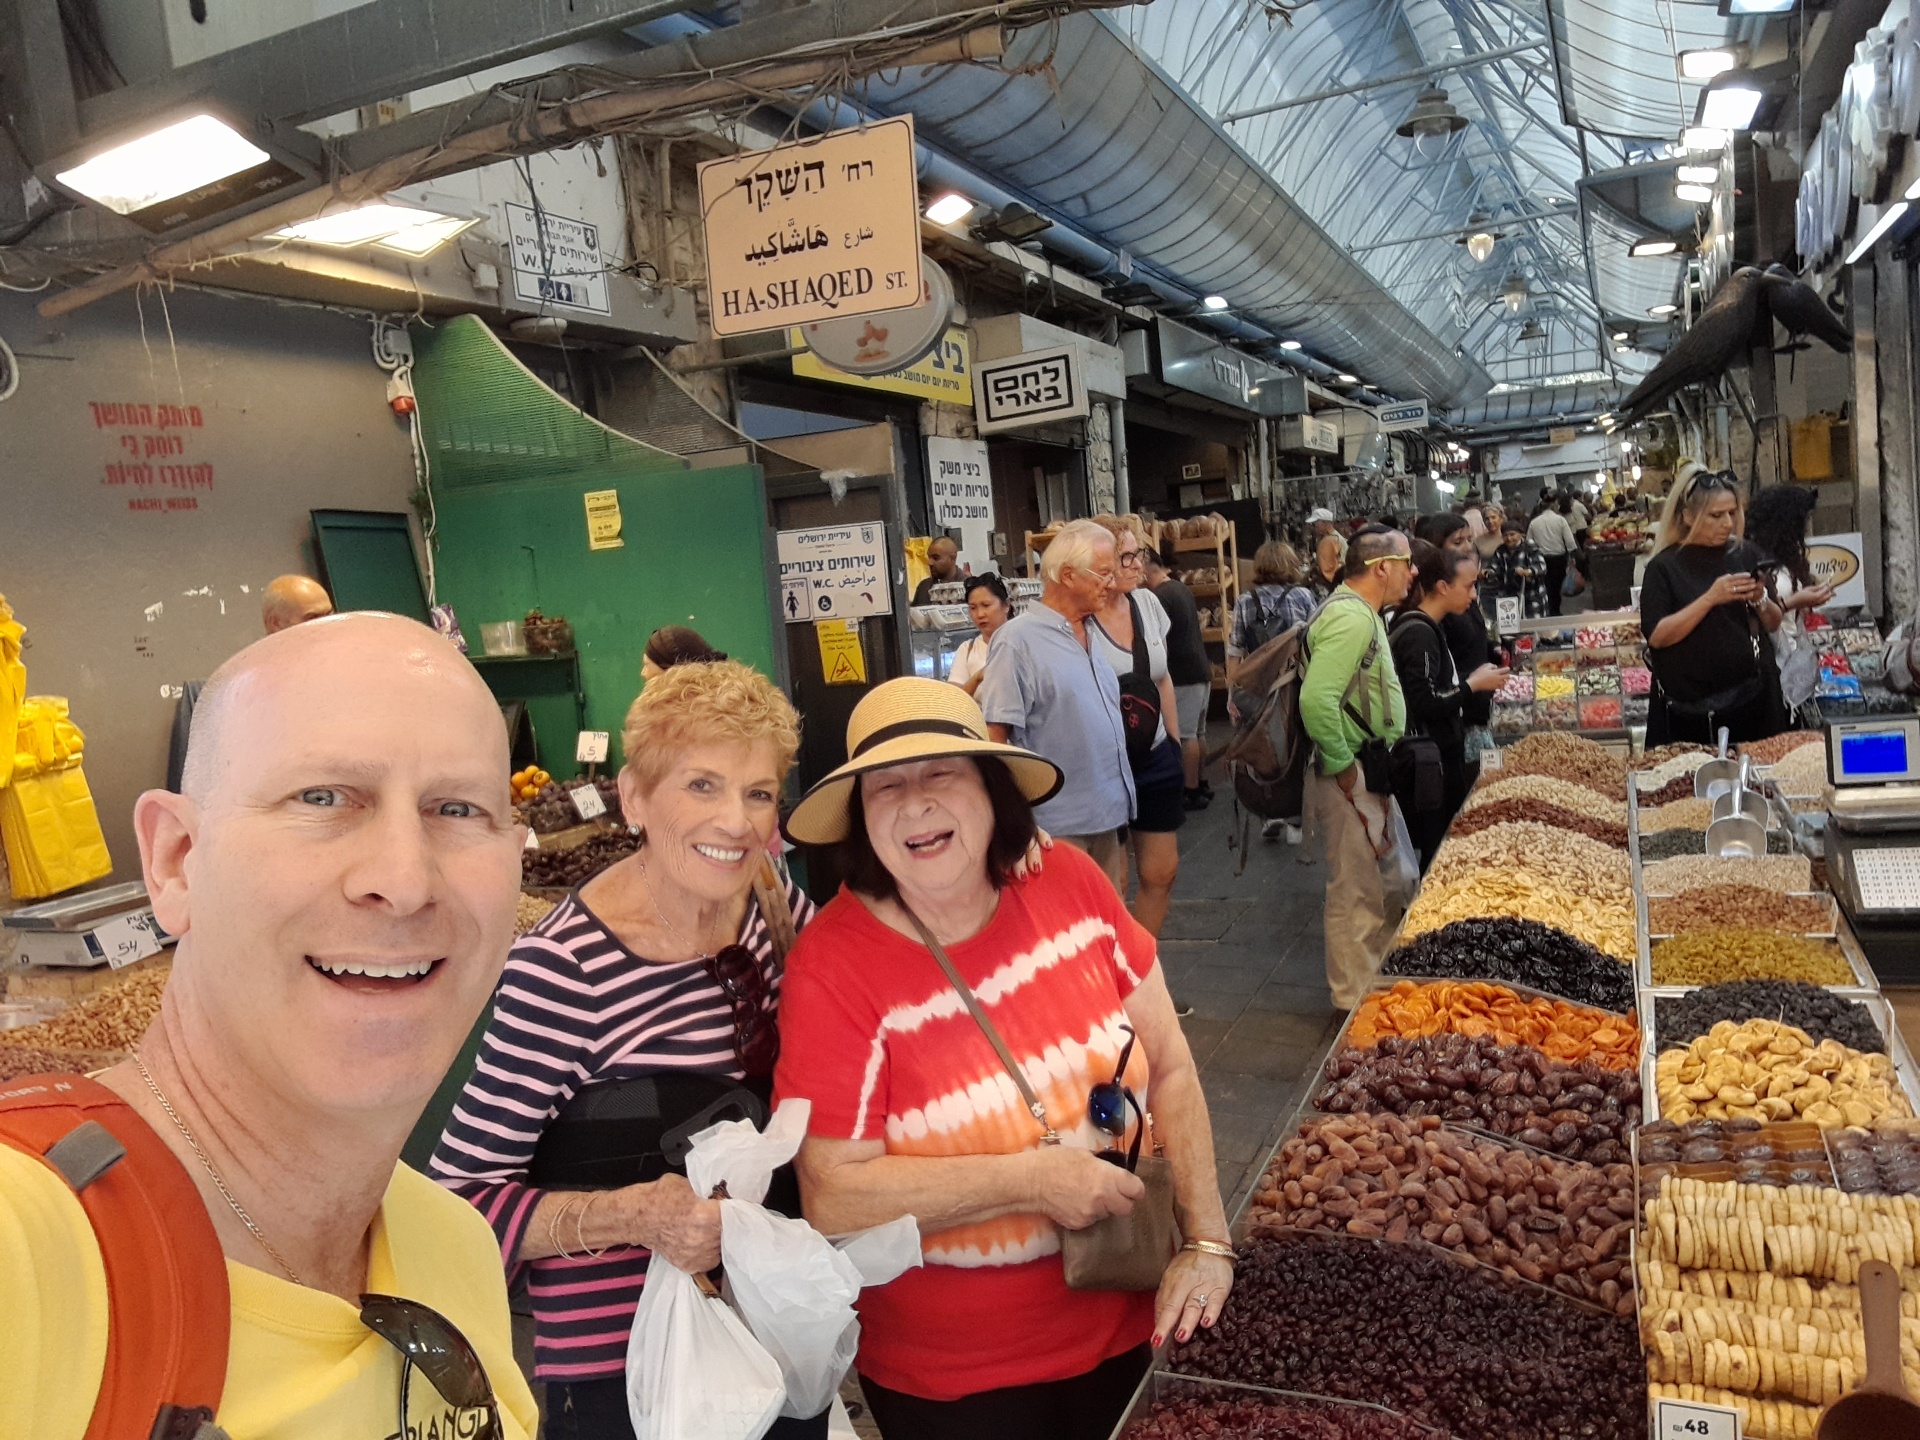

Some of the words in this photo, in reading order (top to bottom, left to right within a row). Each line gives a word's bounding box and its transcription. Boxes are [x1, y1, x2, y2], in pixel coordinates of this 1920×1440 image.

[843, 226, 874, 249] شارع
[560, 246, 598, 265] שירותים
[722, 266, 873, 318] HA-SHAQED
[885, 271, 908, 290] ST.
[903, 370, 921, 382] מושב
[921, 374, 931, 384] יום
[932, 376, 942, 387] יום
[994, 365, 1060, 393] לחם
[942, 379, 960, 391] טריות
[995, 385, 1062, 407] בארי
[939, 460, 961, 478] משק
[963, 462, 981, 477] ביצי
[934, 482, 947, 496] יום
[949, 483, 963, 497] יום
[965, 484, 989, 498] טריות
[939, 499, 963, 524] כסלון
[965, 505, 988, 519] מושב
[797, 533, 827, 544] ירושלים
[828, 531, 851, 541] עיריית
[780, 559, 824, 575] ציבוריים
[828, 554, 876, 571] שירותים
[812, 578, 834, 589] W.C.
[838, 569, 877, 588] مراحيض
[587, 745, 596, 756] 5
[582, 799, 595, 811] 24
[117, 939, 138, 957] 54
